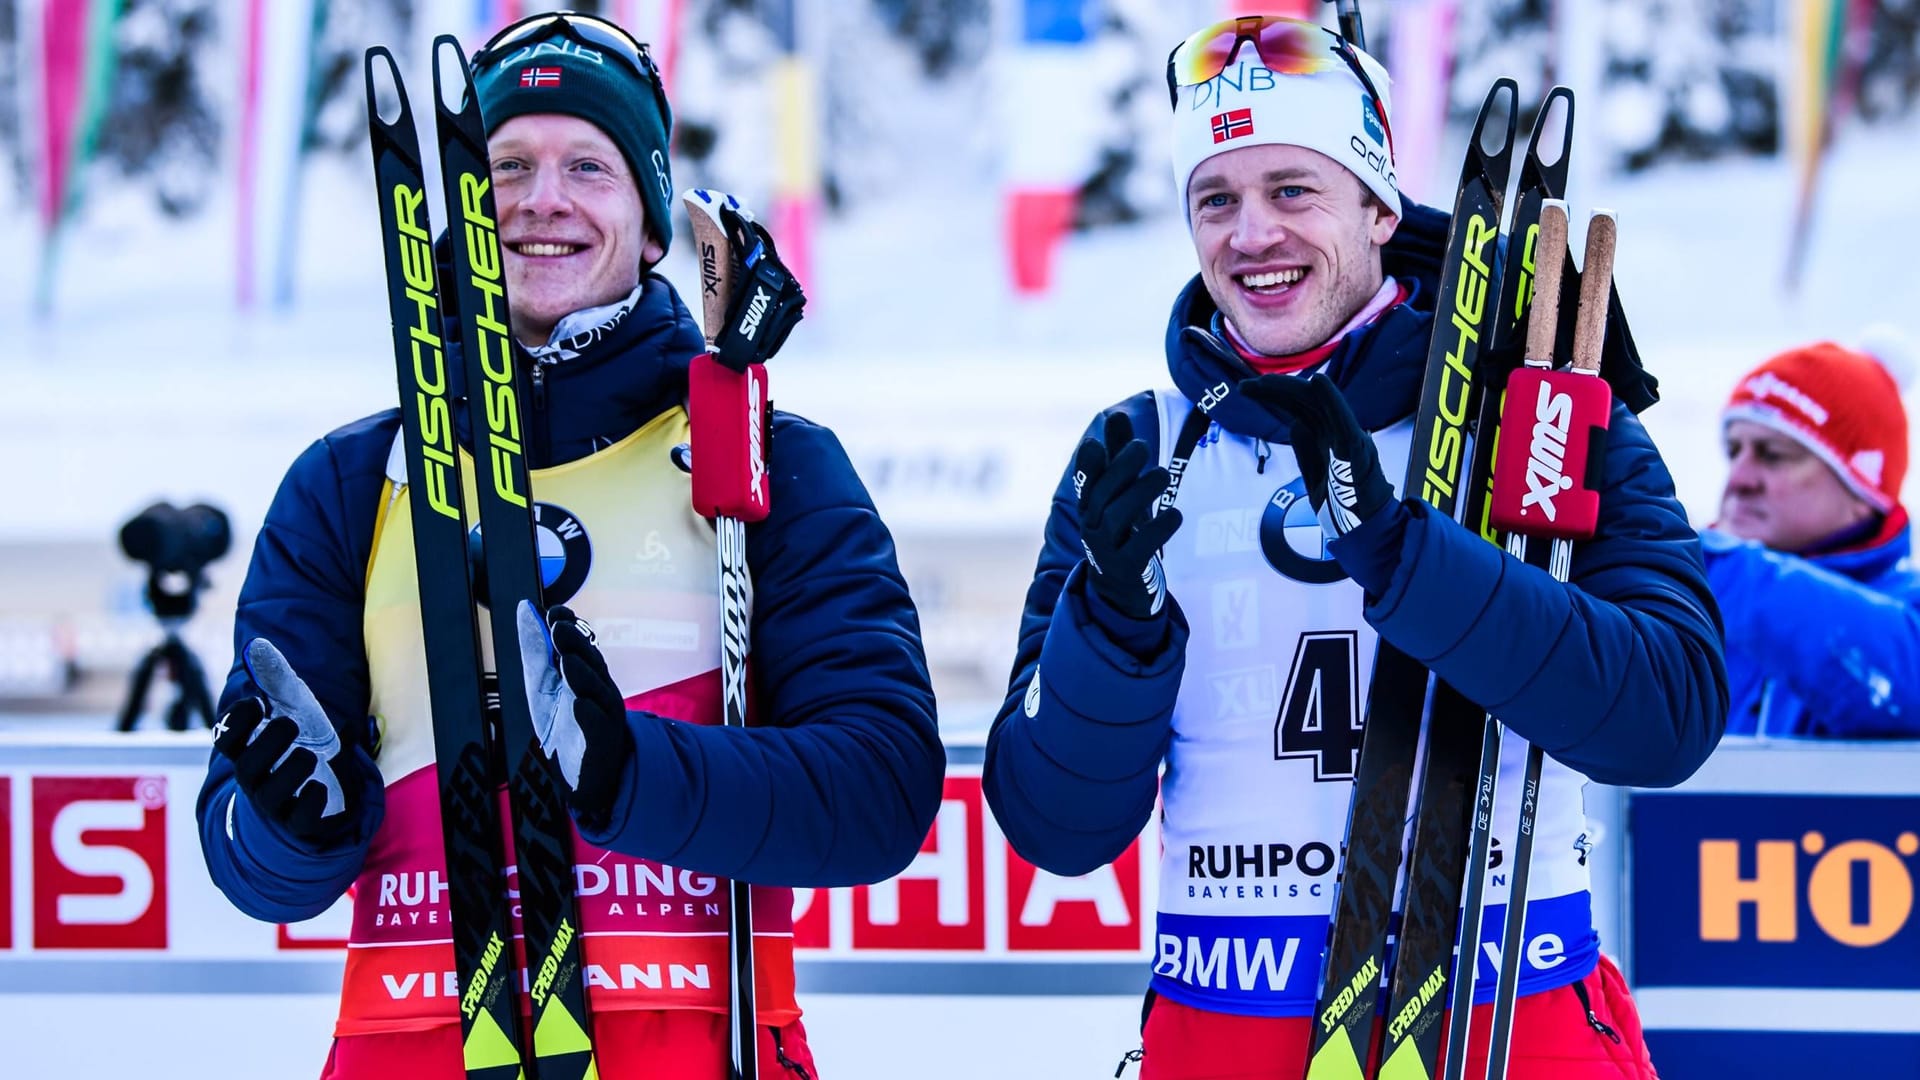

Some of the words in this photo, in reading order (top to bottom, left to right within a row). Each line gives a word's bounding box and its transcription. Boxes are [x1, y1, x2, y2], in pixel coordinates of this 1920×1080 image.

[1193, 61, 1276, 111] DNB
[393, 183, 460, 521] FISCHER
[459, 171, 528, 509] FISCHER
[1422, 213, 1497, 511] FISCHER
[1274, 630, 1364, 783] 4
[1477, 810, 1489, 831] 30
[1480, 774, 1493, 808] TRAC
[1520, 815, 1533, 836] 30
[1524, 779, 1537, 813] TRAC
[608, 902, 719, 916] ALPEN
[1700, 831, 1919, 948] HÖ
[461, 968, 488, 1020] SPEED
[480, 930, 504, 976] MAX
[531, 955, 559, 1007] SPEED
[550, 917, 575, 963] MAX
[1153, 933, 1300, 991] BMW
[1320, 986, 1355, 1033] SPEED
[1351, 955, 1379, 997] MAX
[1388, 996, 1422, 1044] SPEED
[1418, 964, 1447, 1007] MAX
